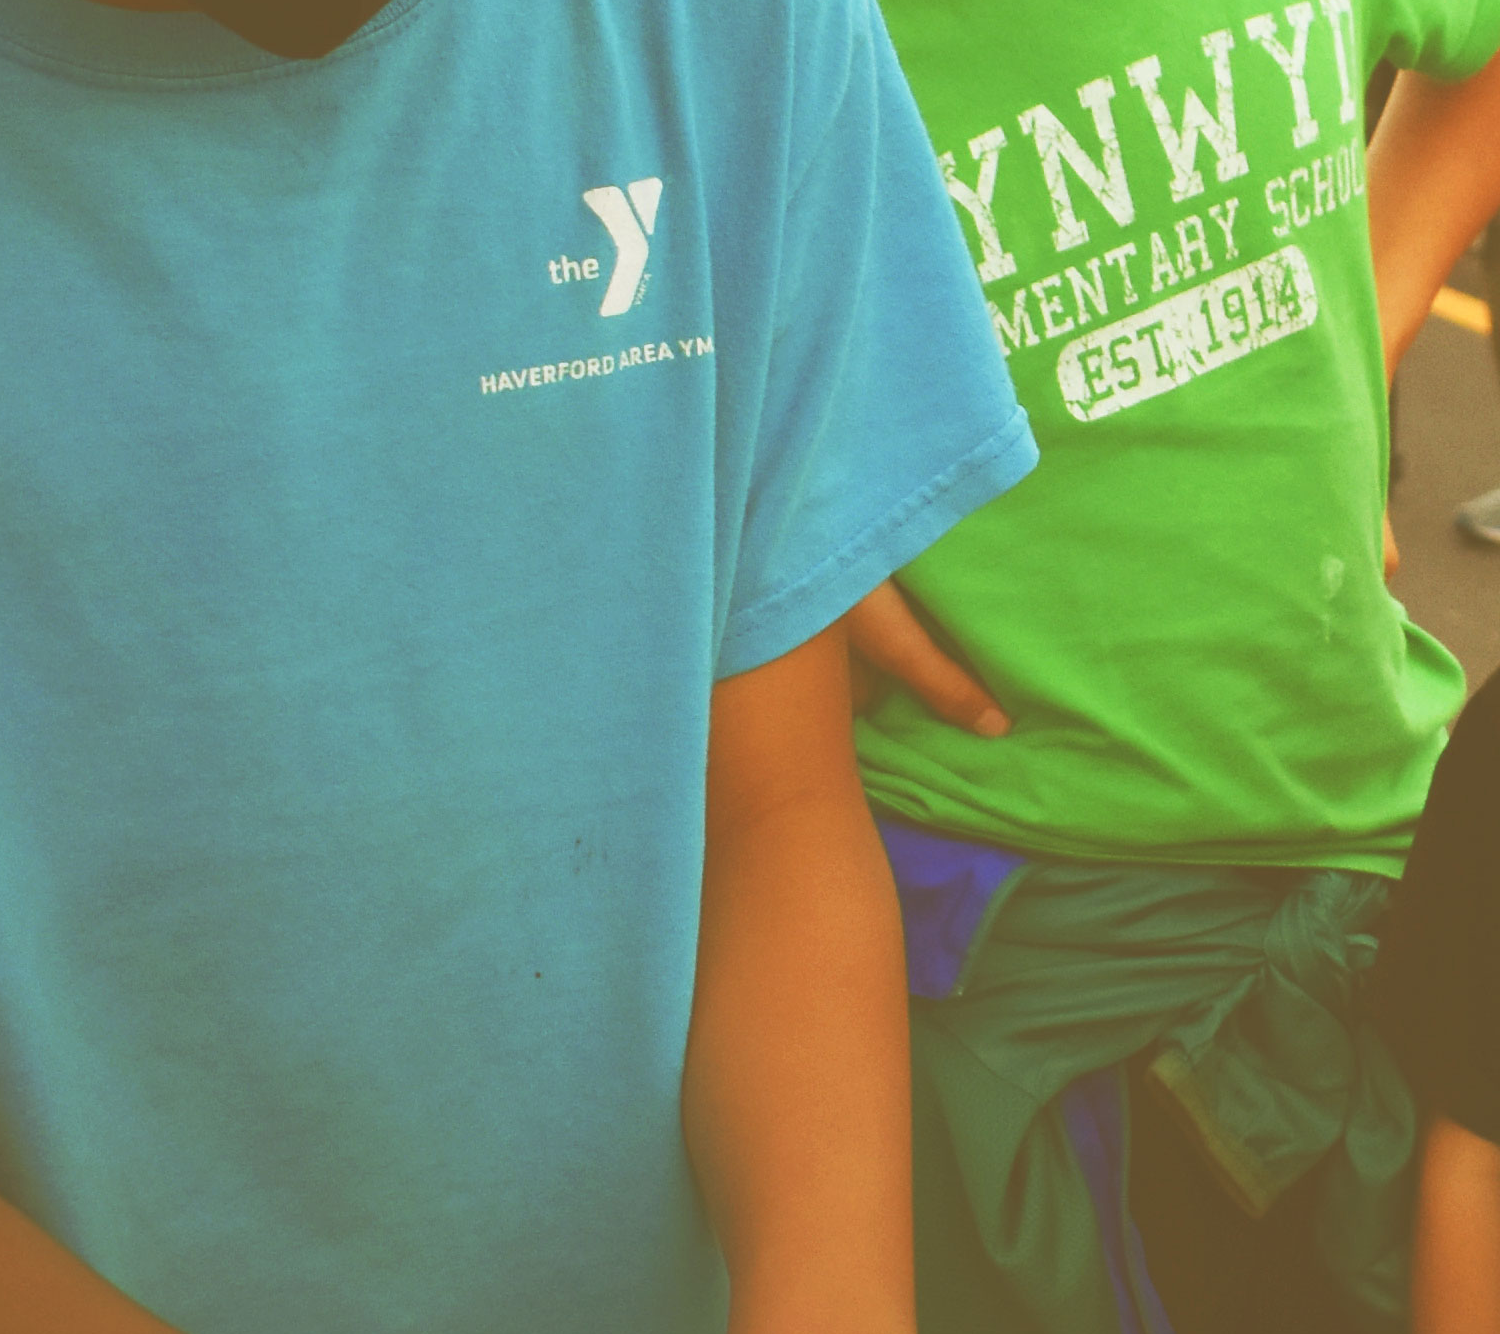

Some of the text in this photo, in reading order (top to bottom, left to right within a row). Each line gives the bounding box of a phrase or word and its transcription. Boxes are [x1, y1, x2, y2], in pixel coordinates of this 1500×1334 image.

[548, 254, 600, 285] the
[1202, 264, 1301, 353] 1914
[480, 355, 615, 395] HAVERFORD
[619, 342, 674, 371] AREA
